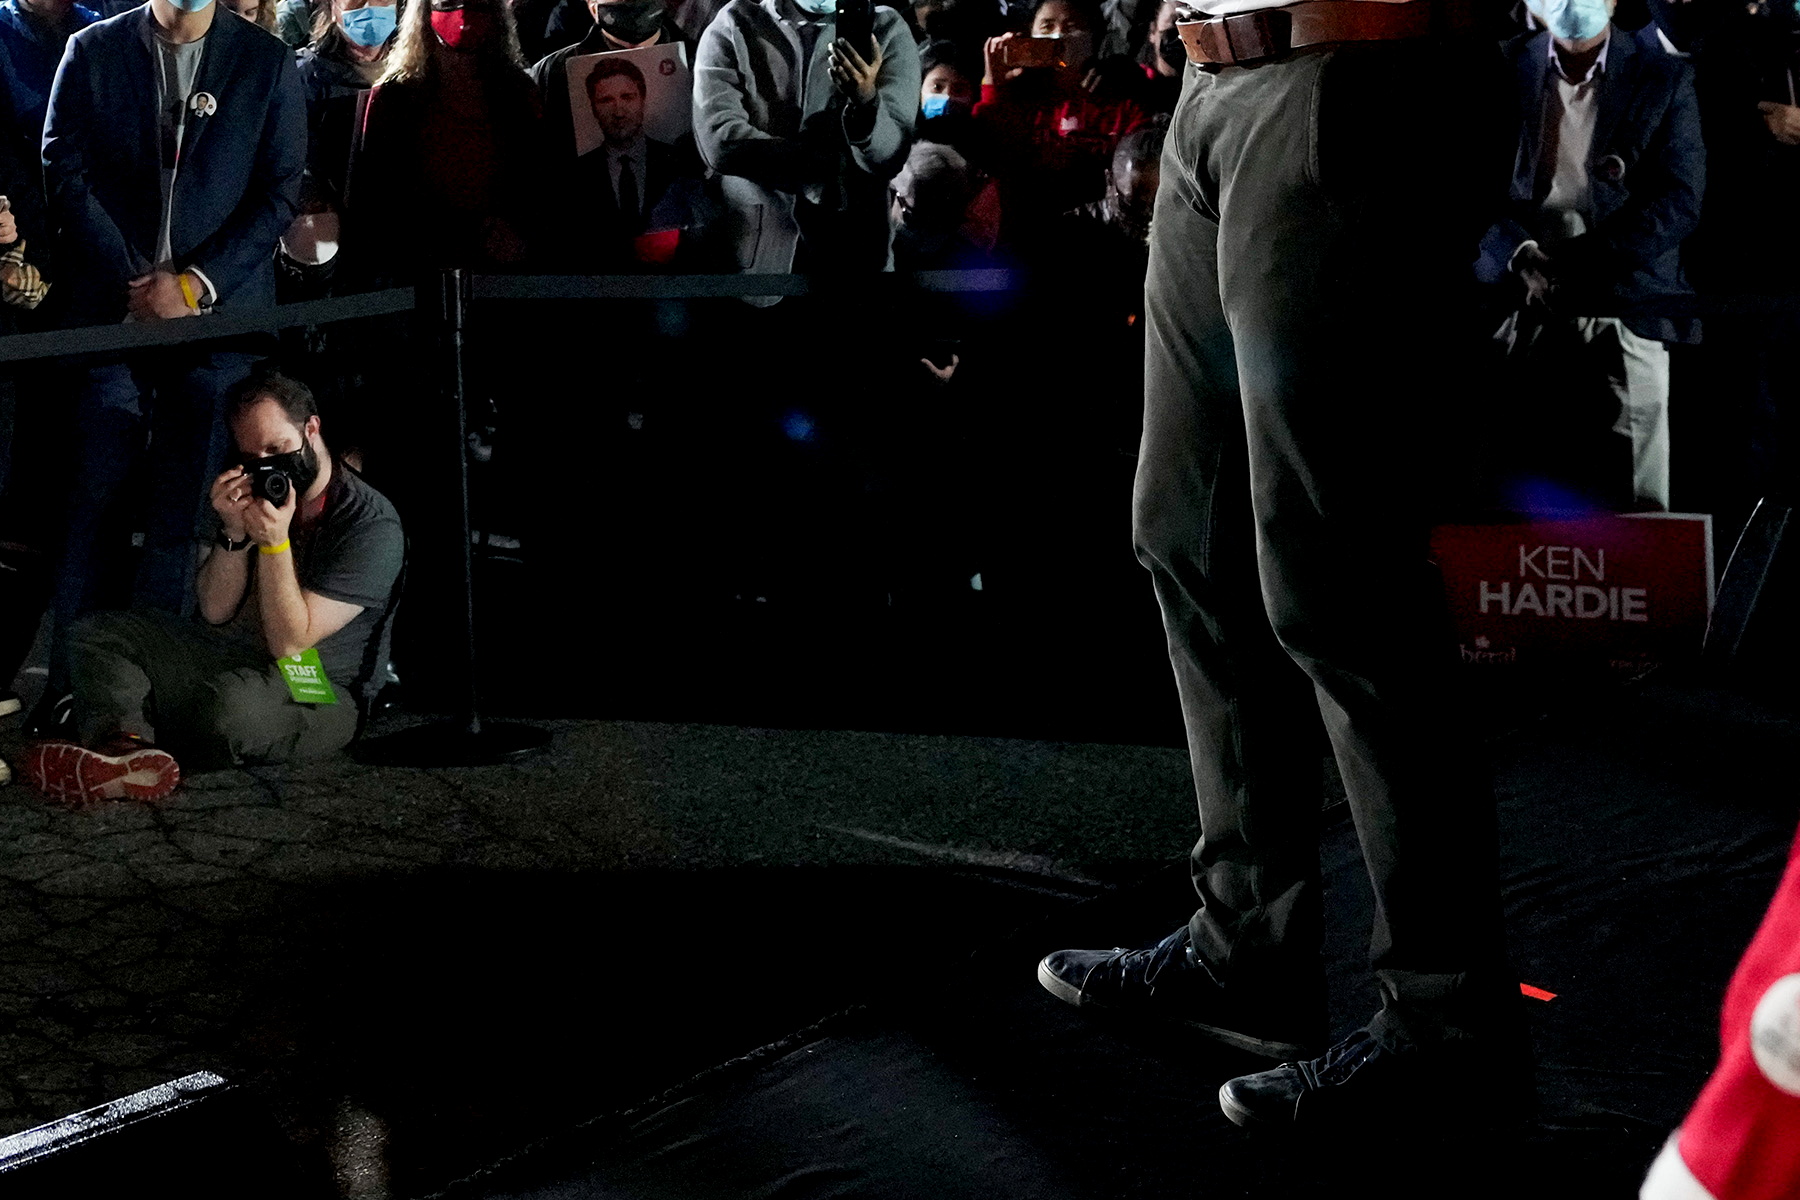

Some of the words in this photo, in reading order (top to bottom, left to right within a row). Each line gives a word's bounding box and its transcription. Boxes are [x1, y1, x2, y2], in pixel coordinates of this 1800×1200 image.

[1518, 544, 1605, 582] KEN
[1479, 580, 1649, 622] HARDIE
[285, 664, 317, 678] STAFF
